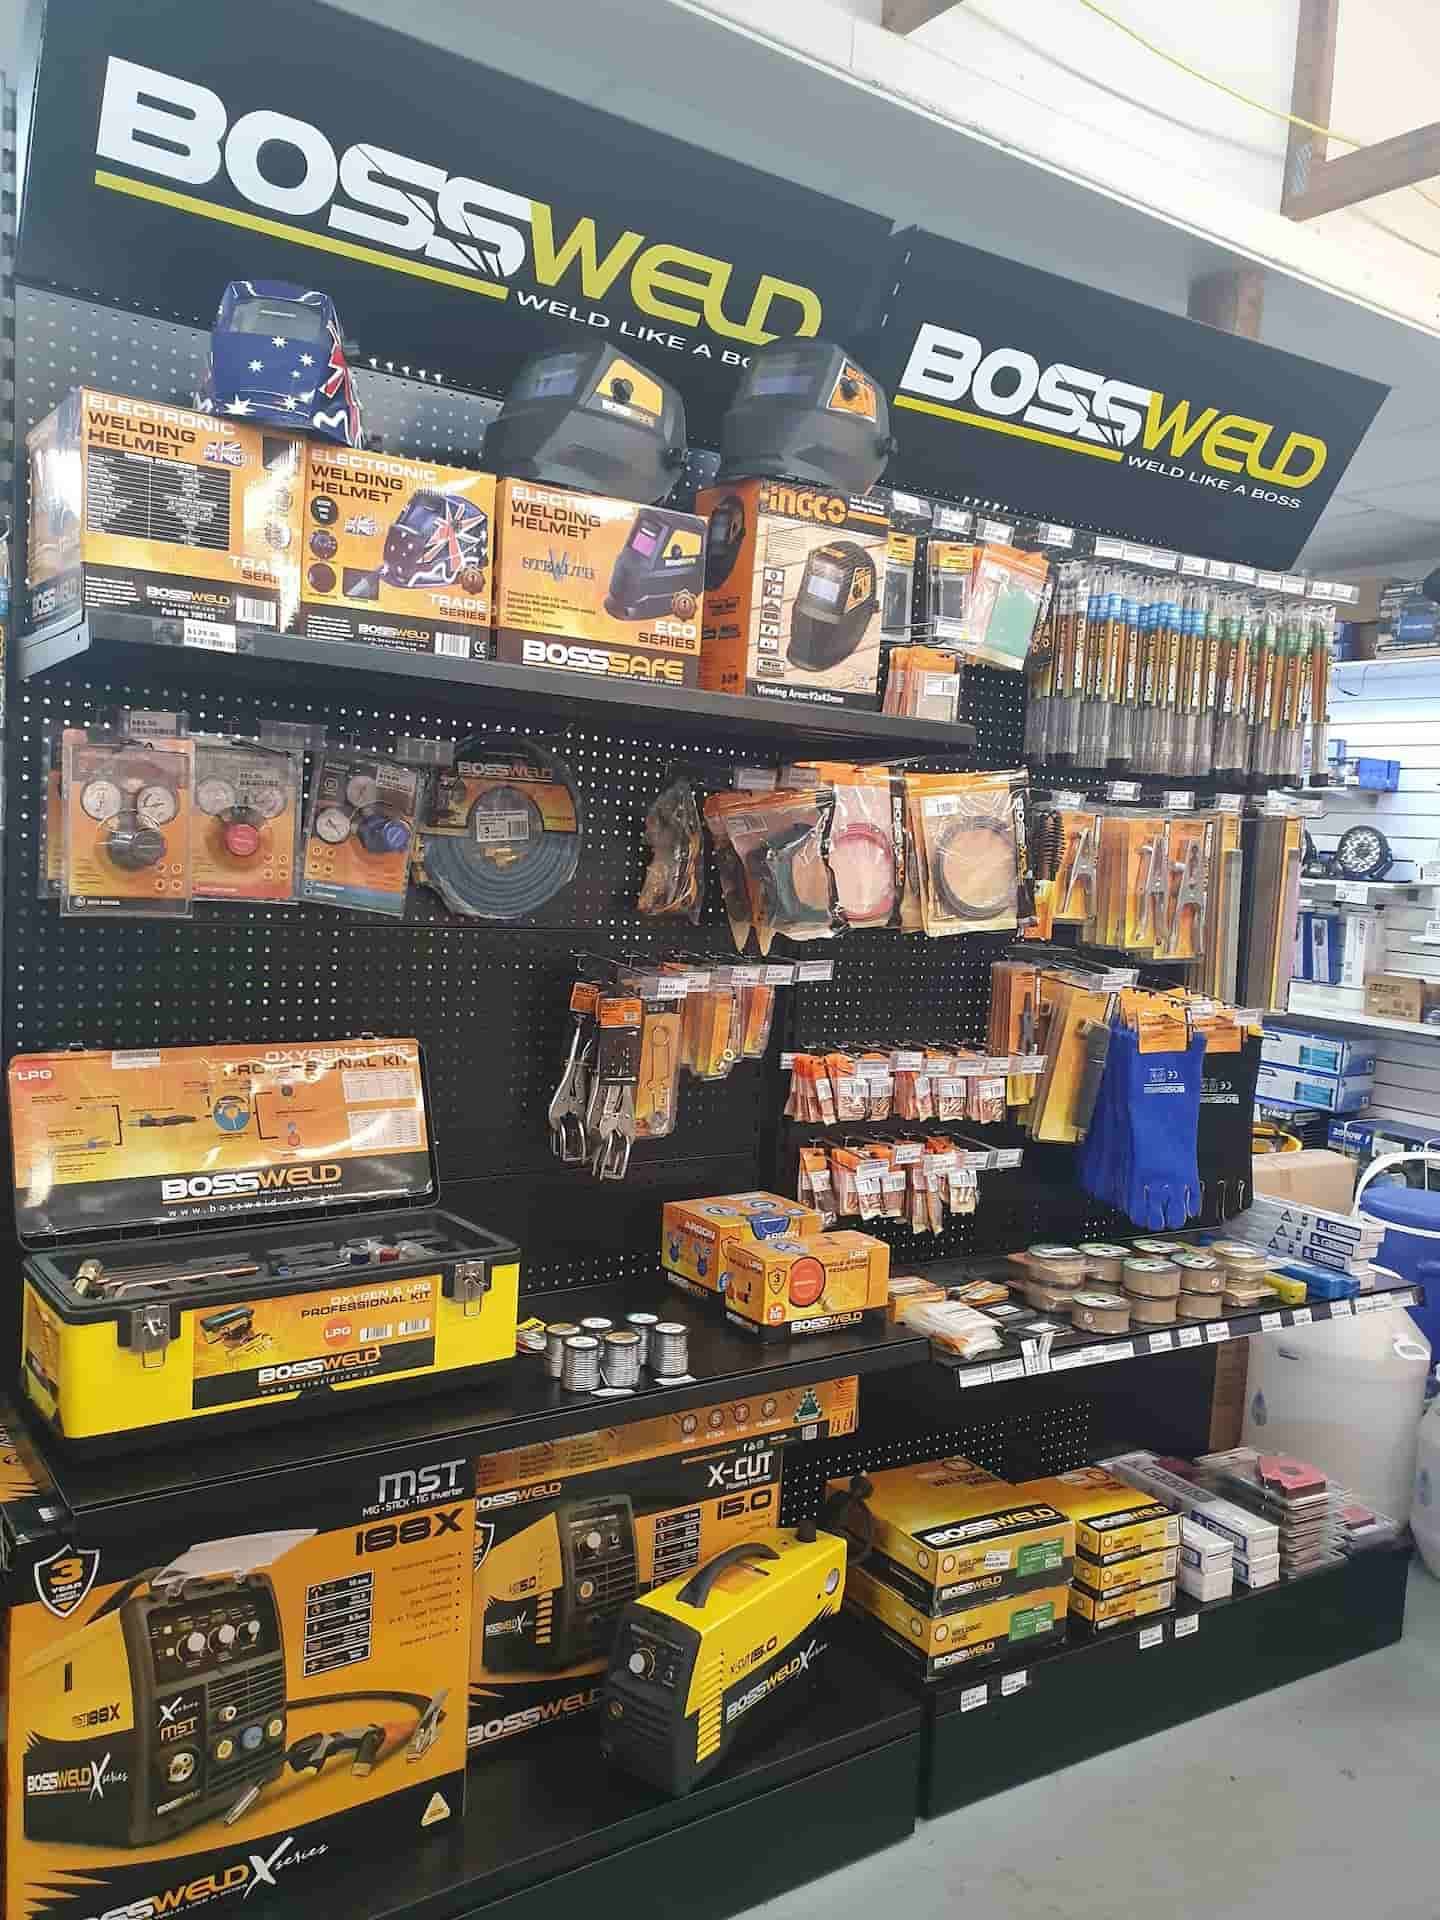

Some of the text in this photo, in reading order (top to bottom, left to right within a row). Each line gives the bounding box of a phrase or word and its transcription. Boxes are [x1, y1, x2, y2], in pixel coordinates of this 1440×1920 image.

[97, 55, 823, 346] BOSSWELD
[516, 291, 712, 359] WELD LIKE A
[87, 393, 237, 434] ELECTRONIC
[899, 321, 1328, 489] BOSSWELD
[88, 411, 197, 444] WELDING
[88, 428, 185, 457] HELMET
[311, 450, 437, 480] ELECTRONIC
[312, 464, 403, 490] WELDING
[311, 480, 393, 504] HELMET
[1128, 455, 1302, 510] WELD LIKE A BOSS
[511, 515, 592, 540] HELMET
[512, 501, 602, 527] WELDING
[241, 569, 281, 585] SERI
[432, 594, 489, 612] TRADE
[439, 607, 486, 622] SERIES
[638, 632, 696, 650] SERIES
[655, 621, 697, 638] ECO
[522, 639, 684, 680] BOSSSAFE
[756, 685, 787, 699] Viewing
[162, 1164, 342, 1202] BOSSWELD
[301, 1290, 431, 1319] PROFESSIONAL KIT
[791, 1311, 863, 1333] BOSSWELD
[258, 1347, 380, 1384] BOSSWELD
[378, 1458, 467, 1504] MST
[707, 1450, 774, 1488] X-CUT
[362, 1504, 380, 1518] MIG
[719, 1489, 772, 1518] 15.0
[355, 1507, 465, 1557] 188X
[924, 1508, 1057, 1545] BOSSWELD
[50, 1558, 84, 1585] 3
[160, 1716, 199, 1742] MST
[26, 1766, 91, 1796] BOSSWELD
